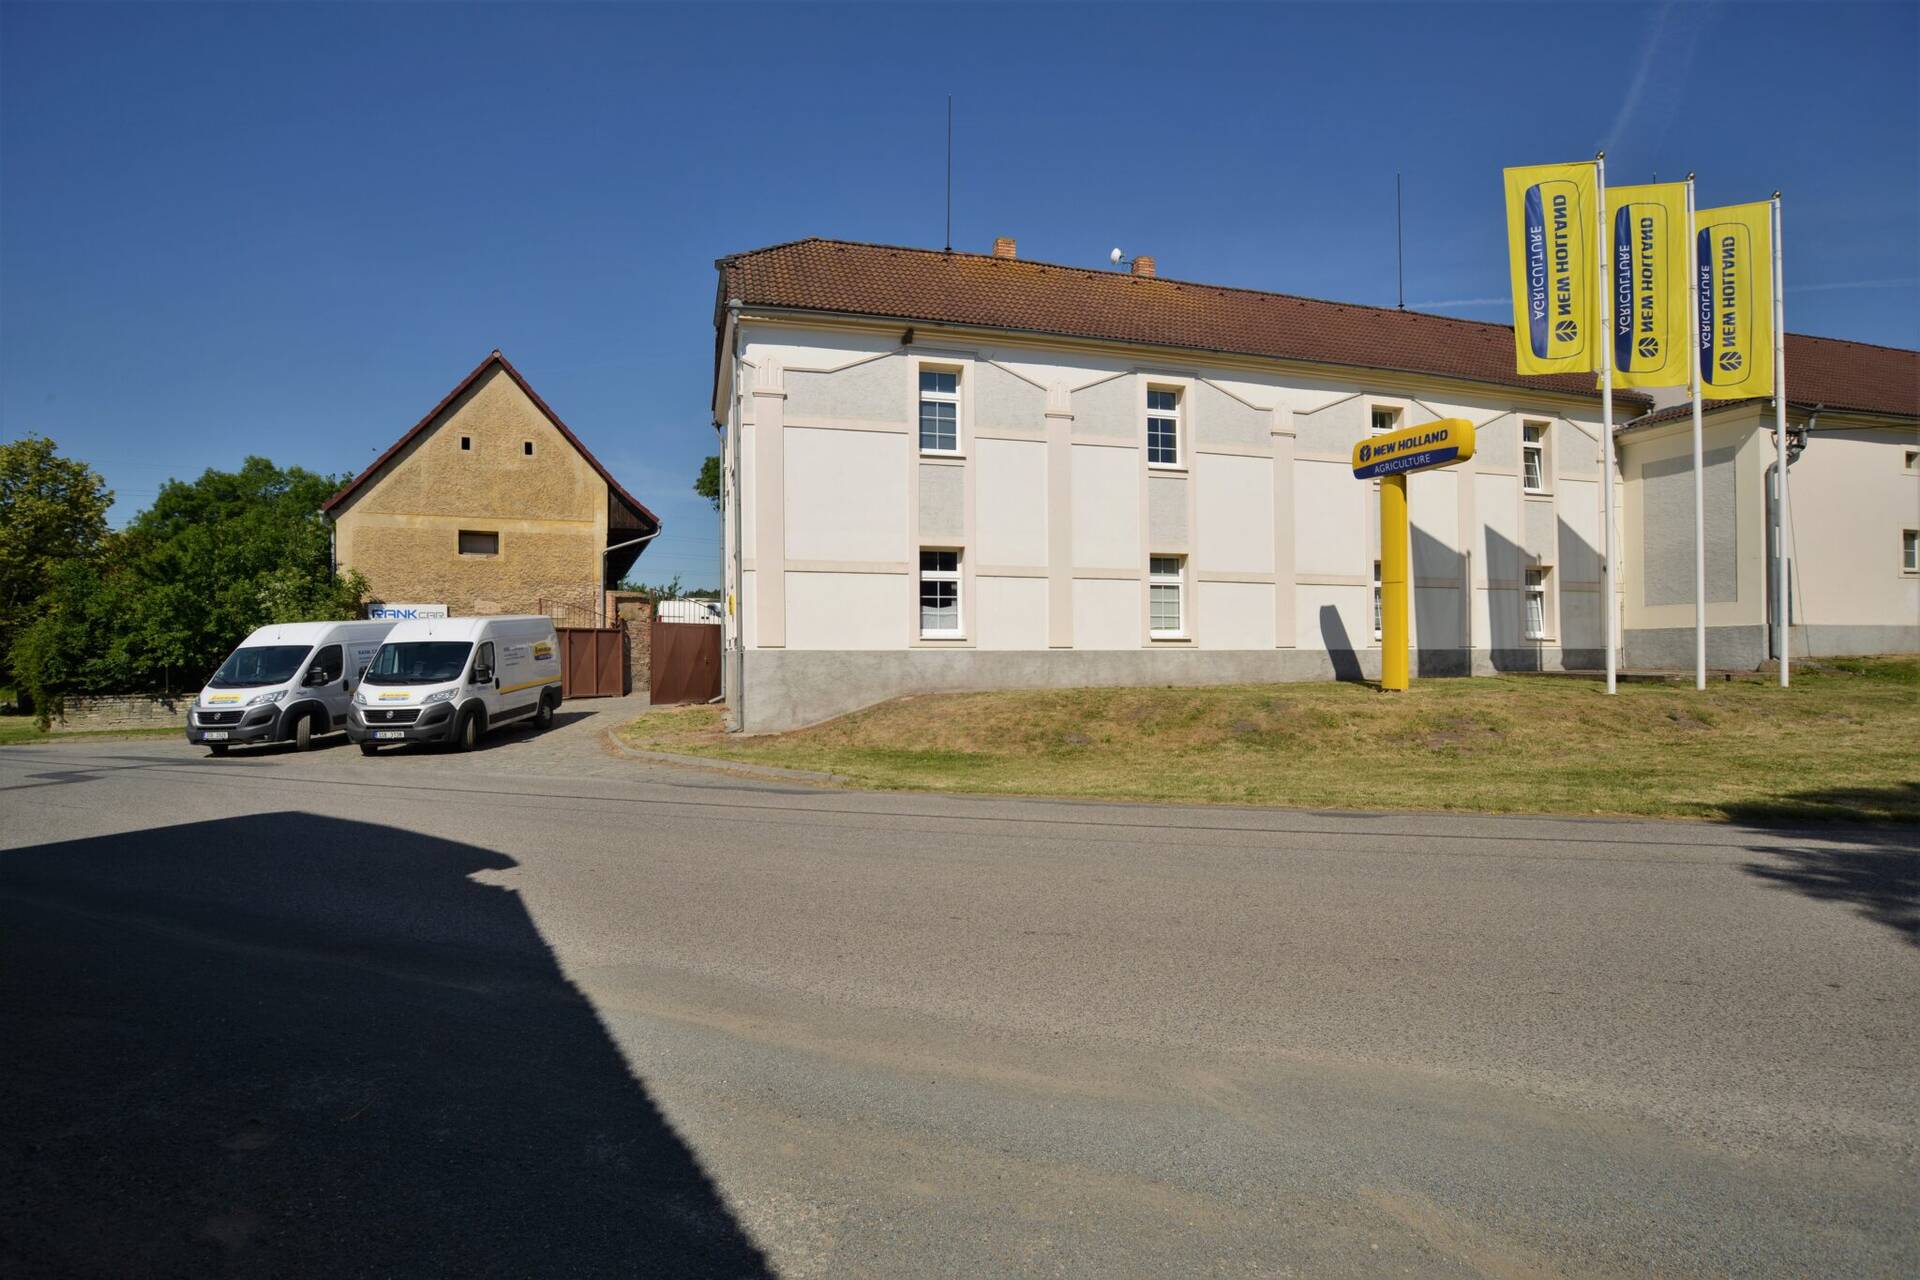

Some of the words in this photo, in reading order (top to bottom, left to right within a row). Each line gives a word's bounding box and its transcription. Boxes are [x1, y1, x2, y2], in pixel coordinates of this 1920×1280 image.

[1373, 441, 1396, 457] NEW
[1398, 429, 1449, 450] HOLLAND
[1374, 453, 1431, 474] AGRICULTURE
[371, 609, 417, 619] RANK
[418, 611, 445, 619] CAR
